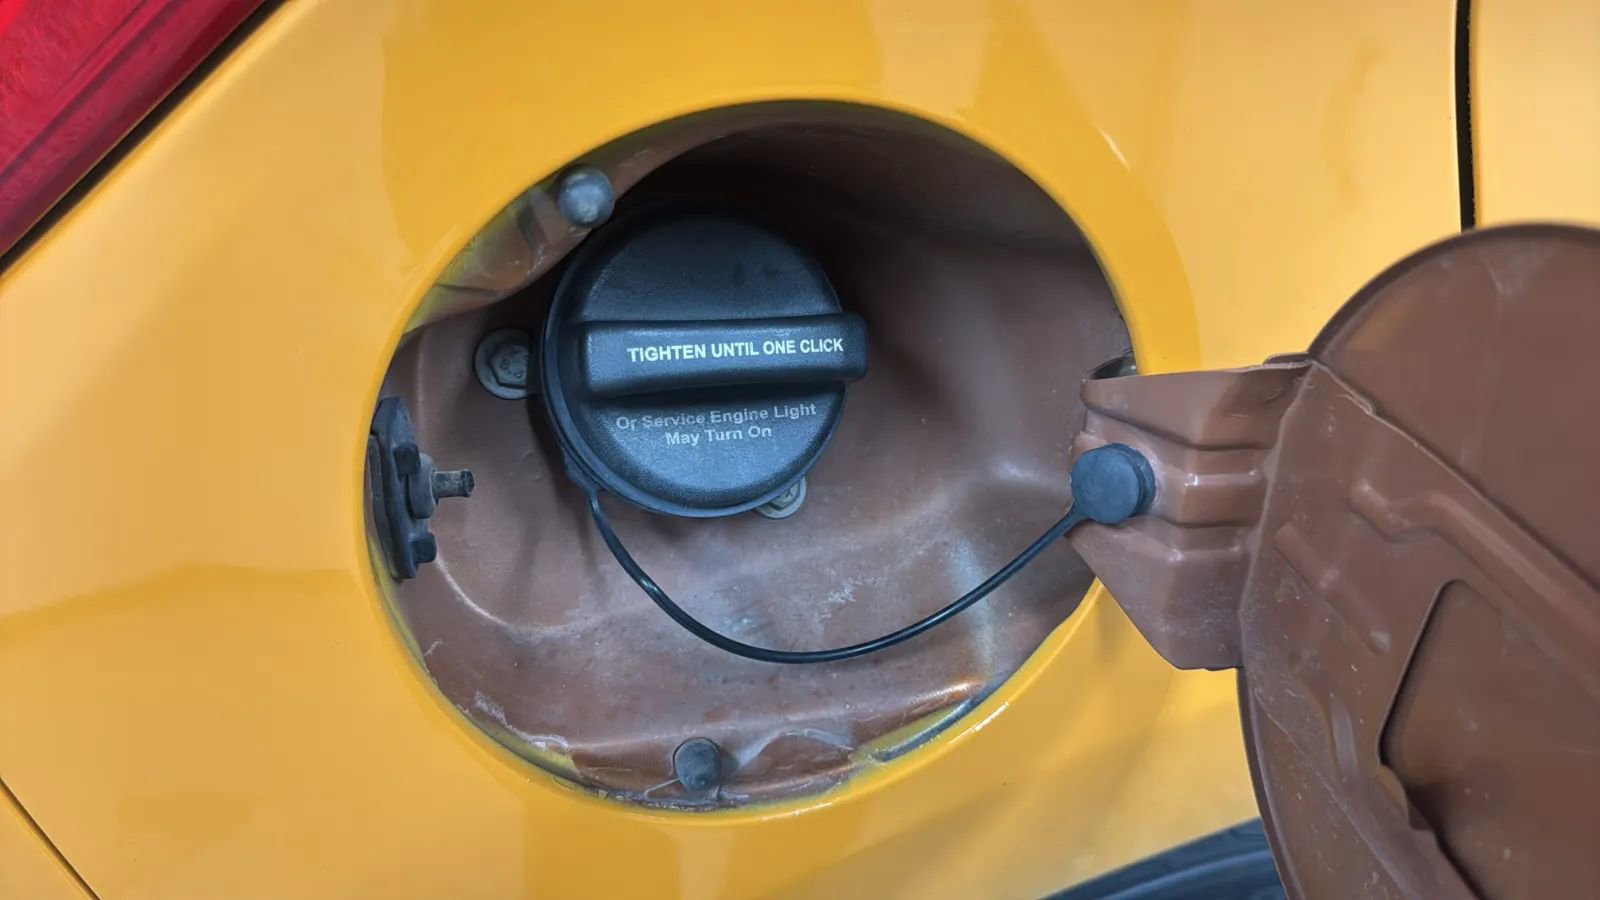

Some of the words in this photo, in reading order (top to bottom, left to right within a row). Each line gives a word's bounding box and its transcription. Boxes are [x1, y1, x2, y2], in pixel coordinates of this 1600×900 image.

[627, 343, 706, 362] TIGHTEN
[711, 341, 760, 358] UNTIL
[763, 340, 796, 355] ONE
[799, 338, 844, 353] CLICK
[616, 416, 636, 431] Or
[642, 413, 705, 428] Service
[710, 406, 769, 425] Engine
[774, 403, 817, 419] Light
[665, 431, 700, 446] May
[704, 428, 743, 442] Turn
[748, 425, 772, 438] On
